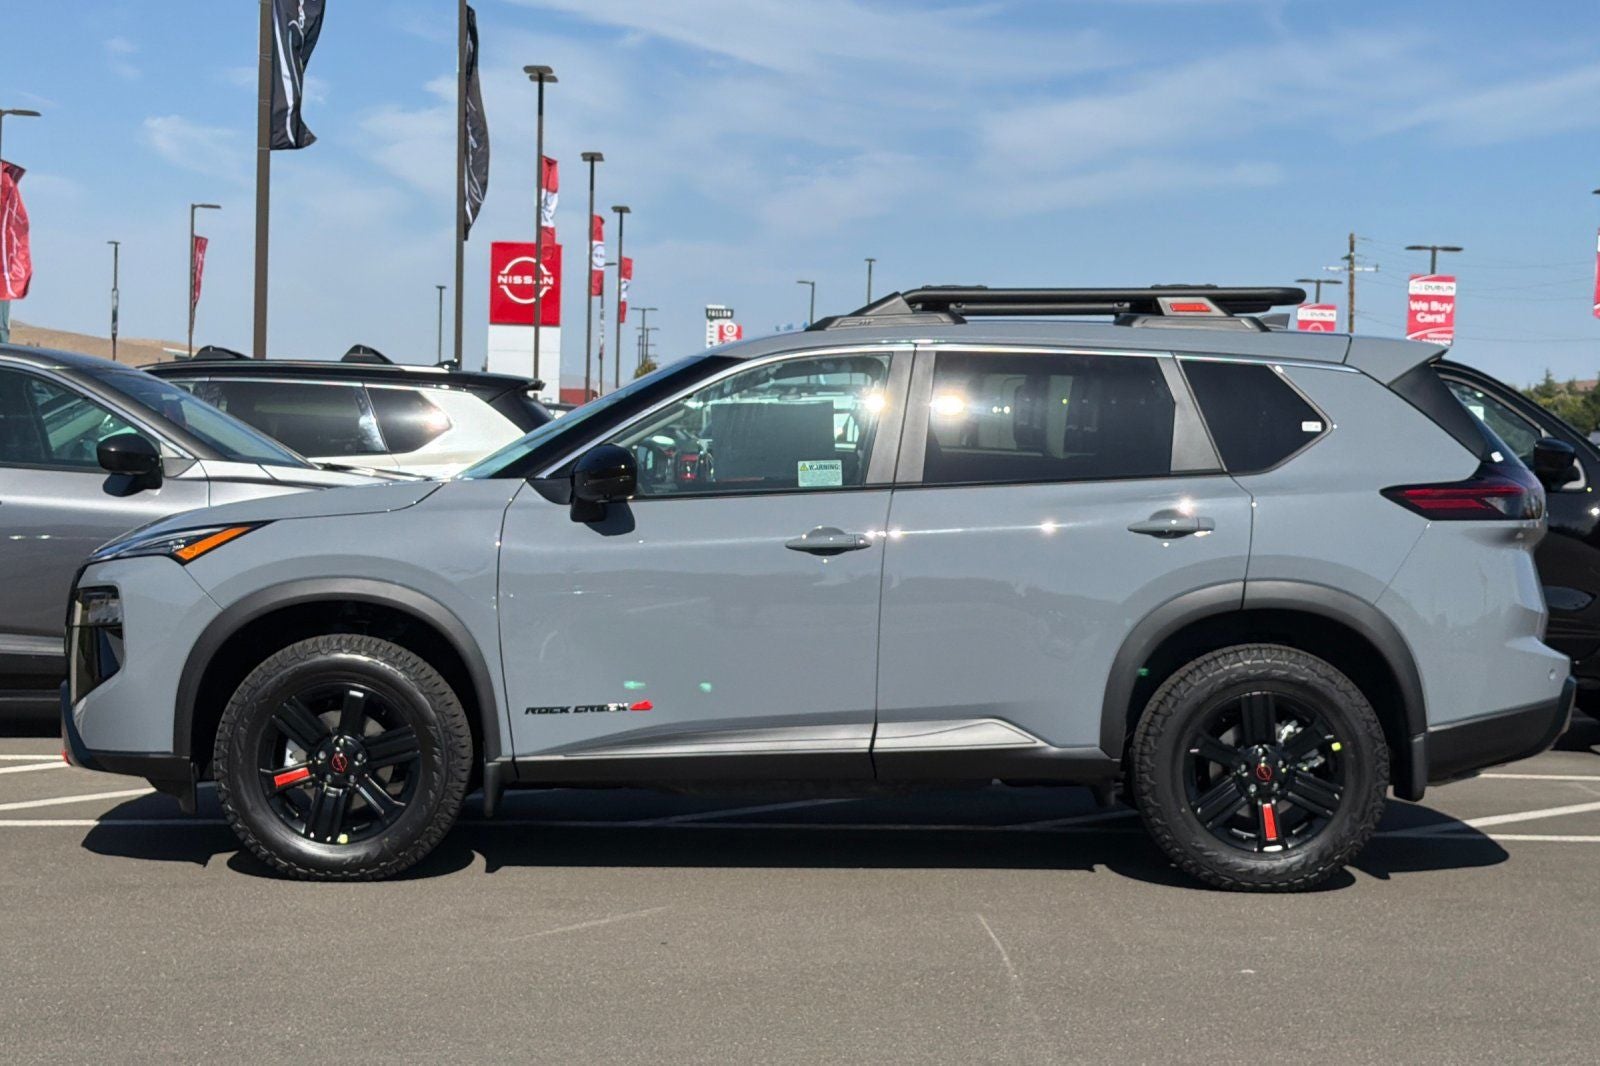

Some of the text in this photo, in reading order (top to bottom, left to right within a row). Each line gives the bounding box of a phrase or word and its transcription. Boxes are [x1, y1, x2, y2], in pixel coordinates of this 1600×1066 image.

[1410, 300, 1453, 314] We Buy
[525, 705, 571, 715] ROCK
